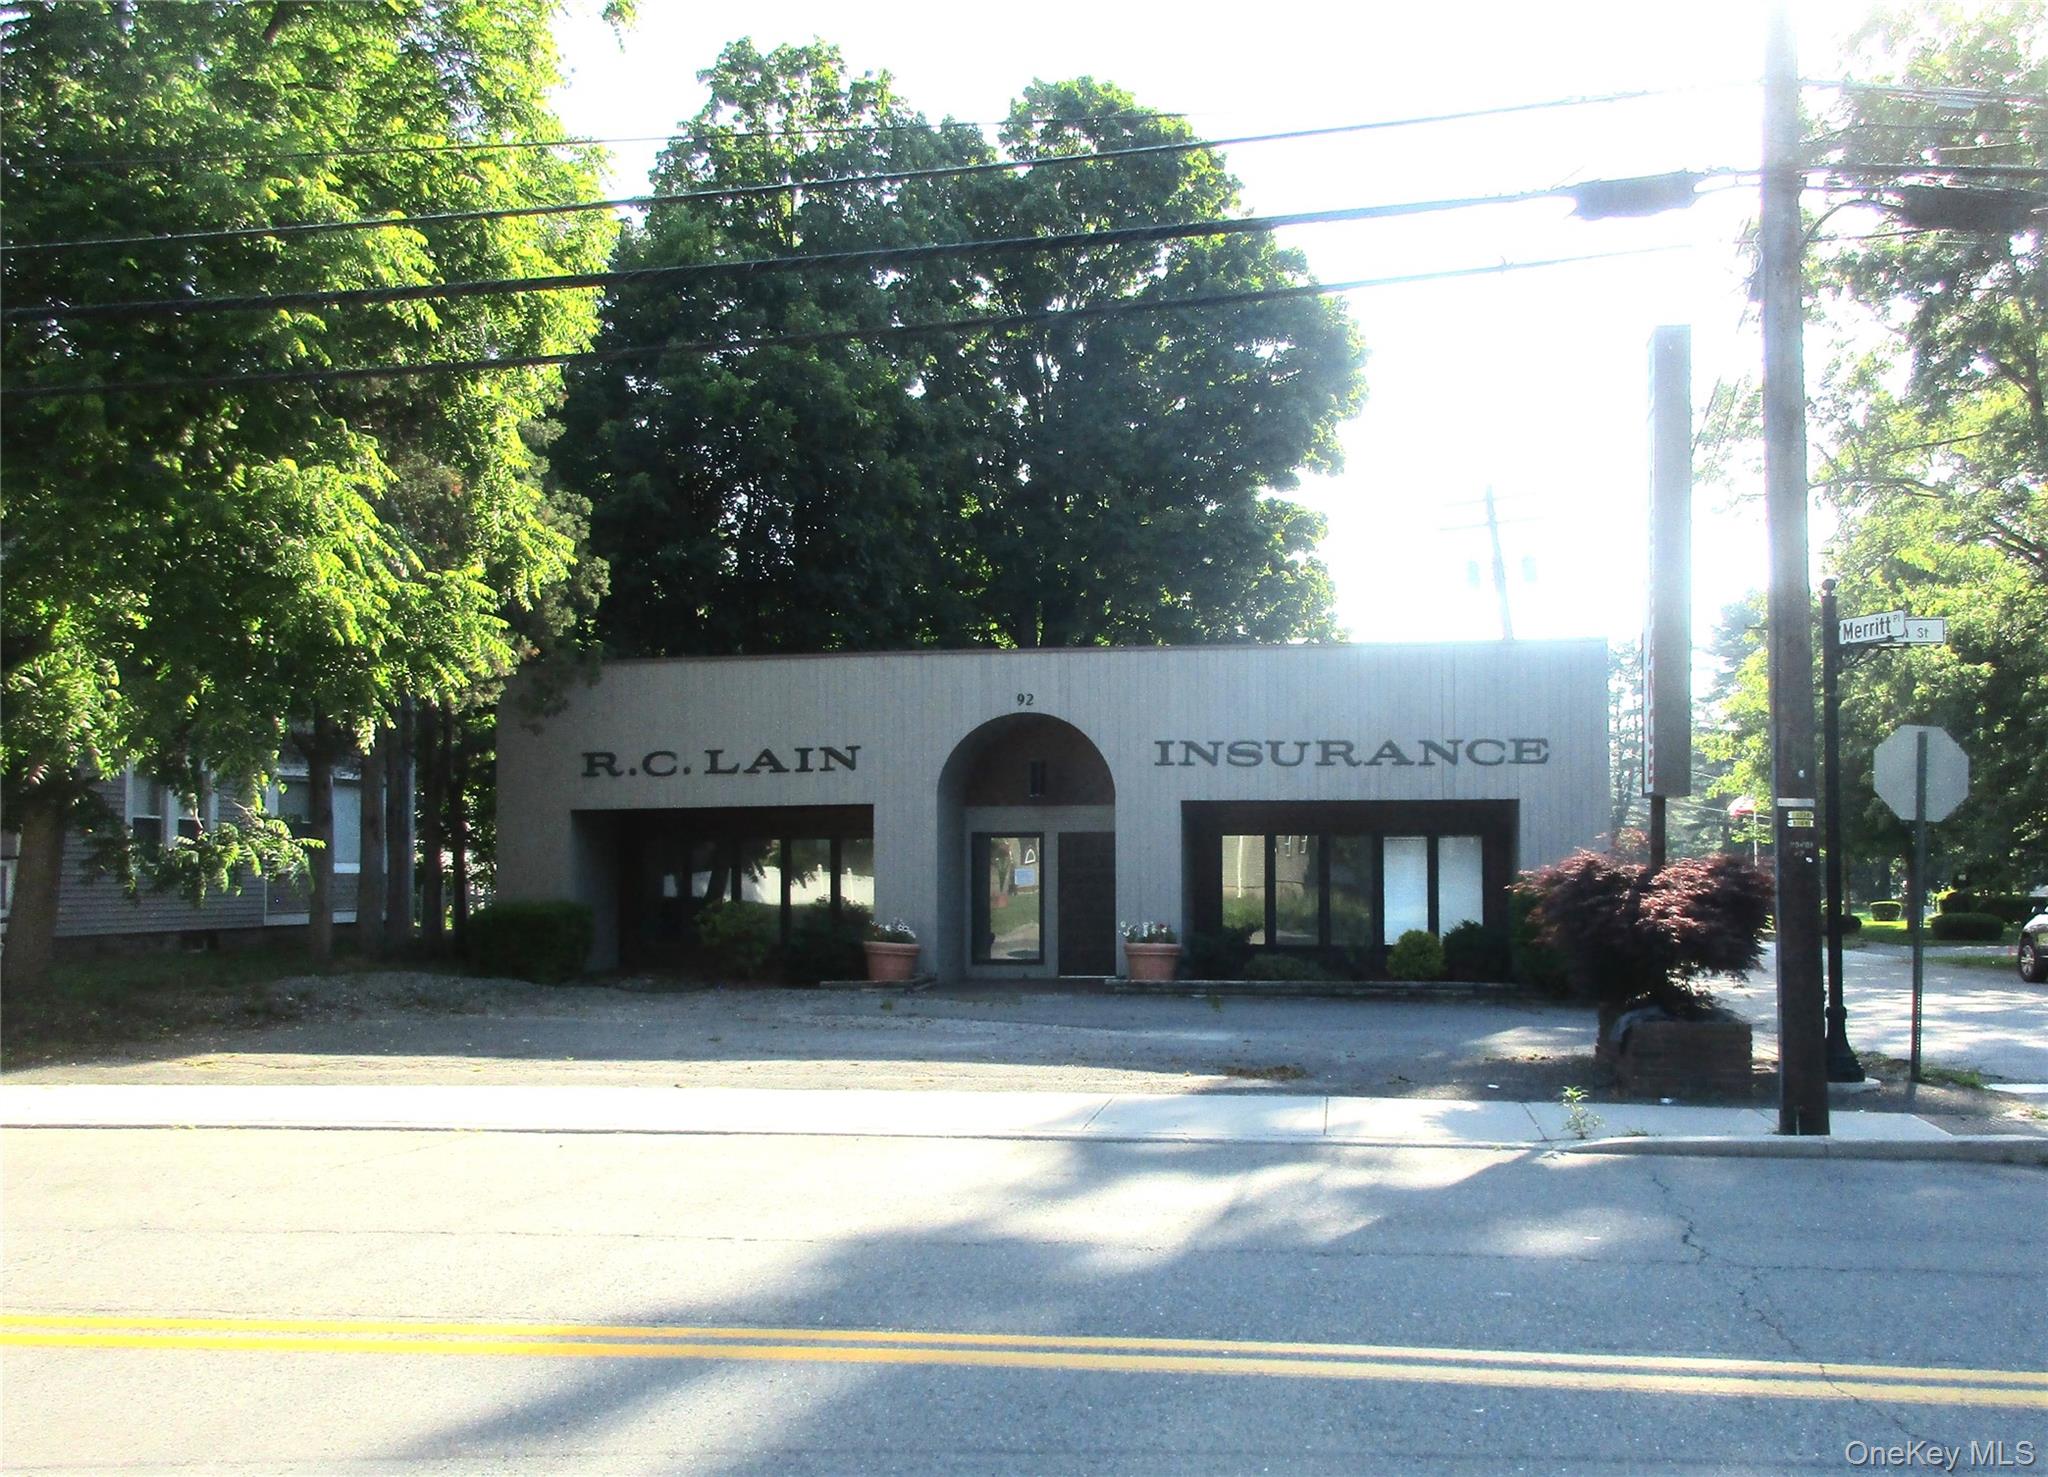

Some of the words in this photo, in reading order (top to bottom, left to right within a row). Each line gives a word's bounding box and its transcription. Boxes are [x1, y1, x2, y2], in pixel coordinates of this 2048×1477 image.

[1843, 616, 1891, 640] Merritt
[1917, 627, 1928, 638] St
[1017, 693, 1034, 706] 92
[1153, 738, 1549, 767] INSURANCE
